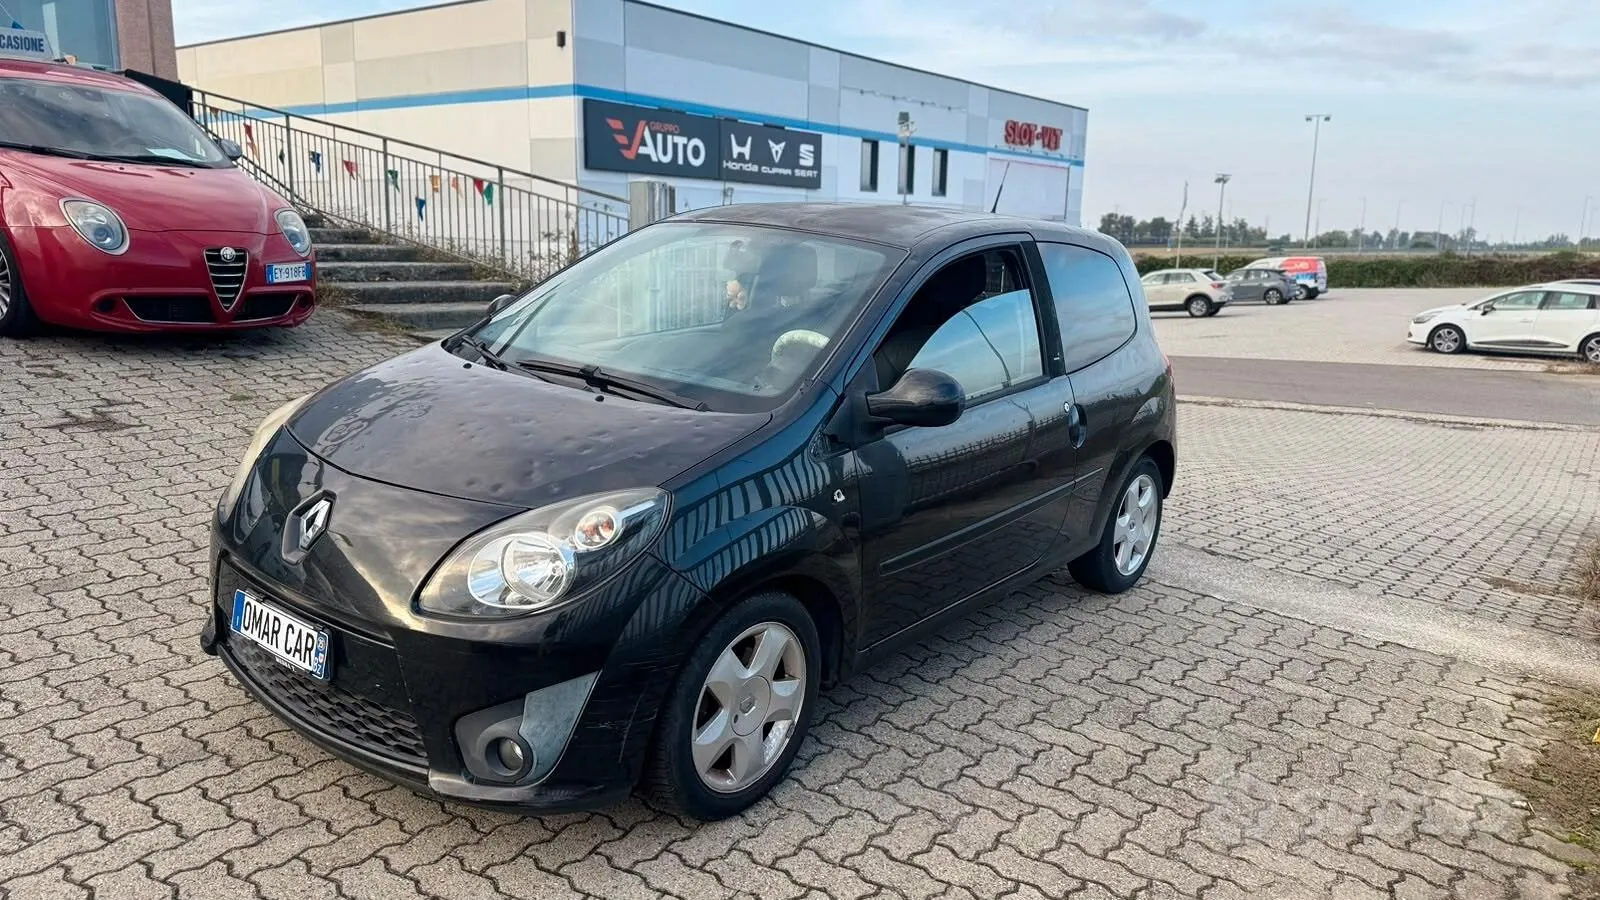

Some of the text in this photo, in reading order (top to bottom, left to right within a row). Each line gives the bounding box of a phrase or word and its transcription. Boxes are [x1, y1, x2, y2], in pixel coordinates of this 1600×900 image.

[649, 121, 681, 134] GRUPPO
[723, 159, 819, 178] Honda CUPRA SEAT
[243, 601, 281, 648] OMAR
[284, 623, 316, 667] CAR
